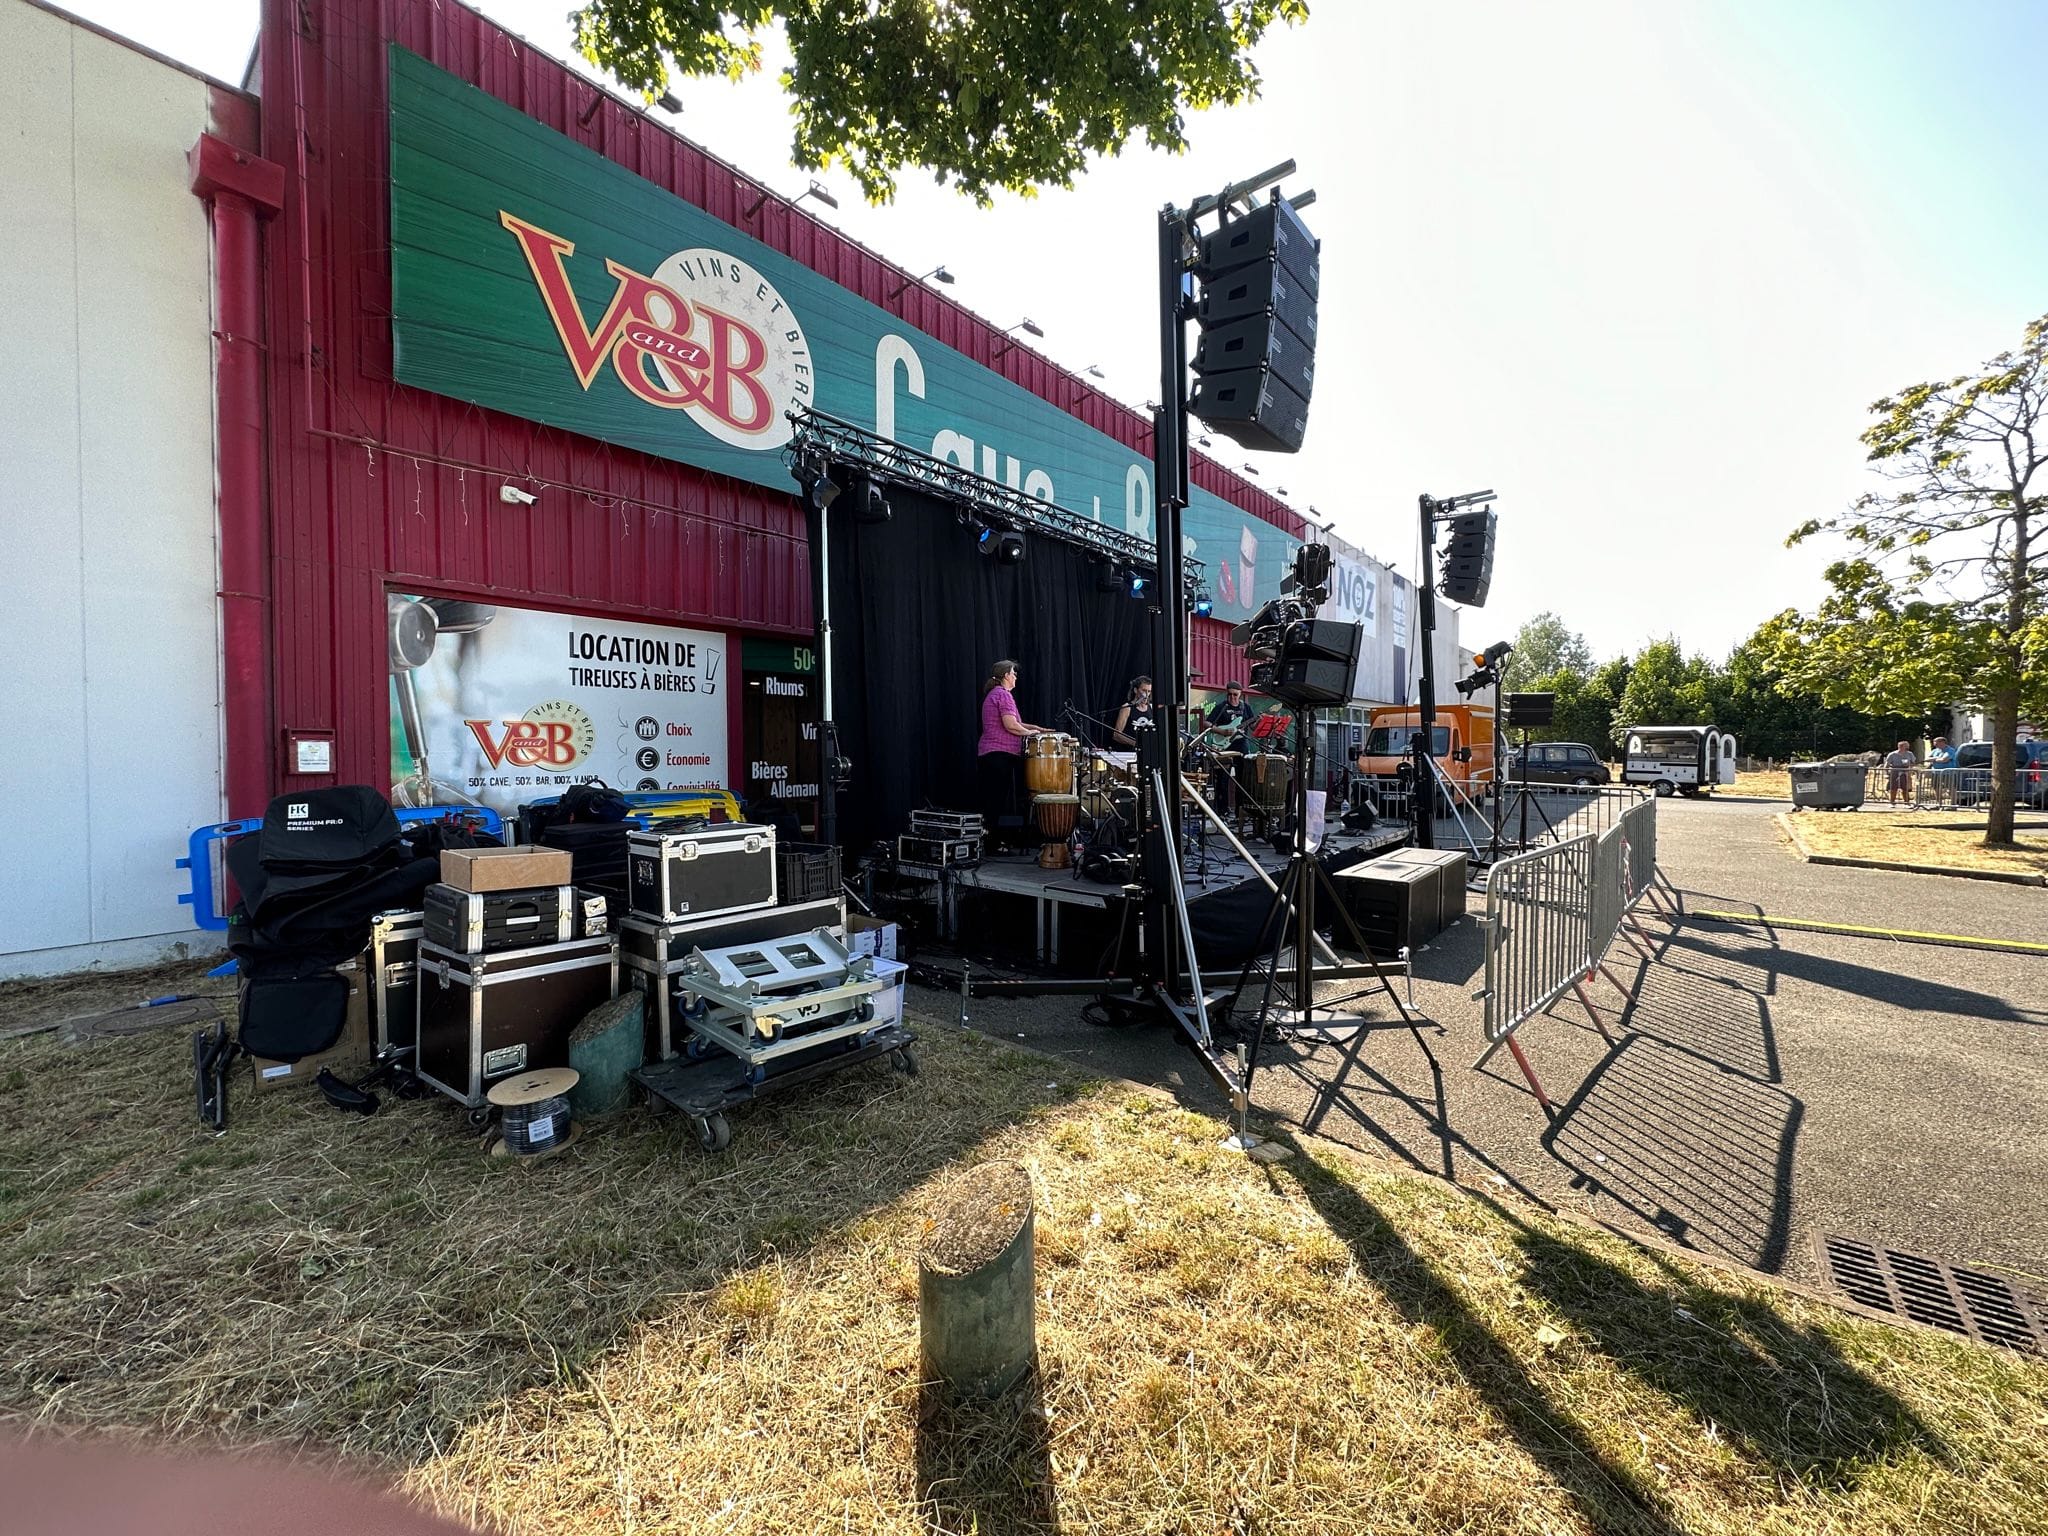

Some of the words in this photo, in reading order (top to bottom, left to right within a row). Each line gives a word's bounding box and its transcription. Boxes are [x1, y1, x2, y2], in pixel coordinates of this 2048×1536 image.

[679, 256, 741, 284] VINS
[756, 282, 784, 314] ET
[785, 329, 810, 409] BIERE
[631, 329, 701, 363] and
[1337, 565, 1375, 620] NOZ
[568, 631, 670, 666] LOCATION
[675, 642, 696, 668] DE
[568, 667, 637, 690] TIREUSES
[640, 667, 651, 690] À
[654, 669, 696, 693] BIÈRES
[765, 676, 804, 697] Rhums
[533, 701, 561, 716] VINS
[567, 704, 581, 715] ET
[580, 717, 594, 756] BIERES
[666, 722, 692, 736] Choix
[514, 738, 544, 747] and
[666, 749, 711, 766] Économie
[752, 760, 788, 779] Bières
[468, 777, 486, 787] 50%
[515, 776, 533, 786] 50%
[554, 775, 572, 785] 100%
[290, 805, 306, 814] HK
